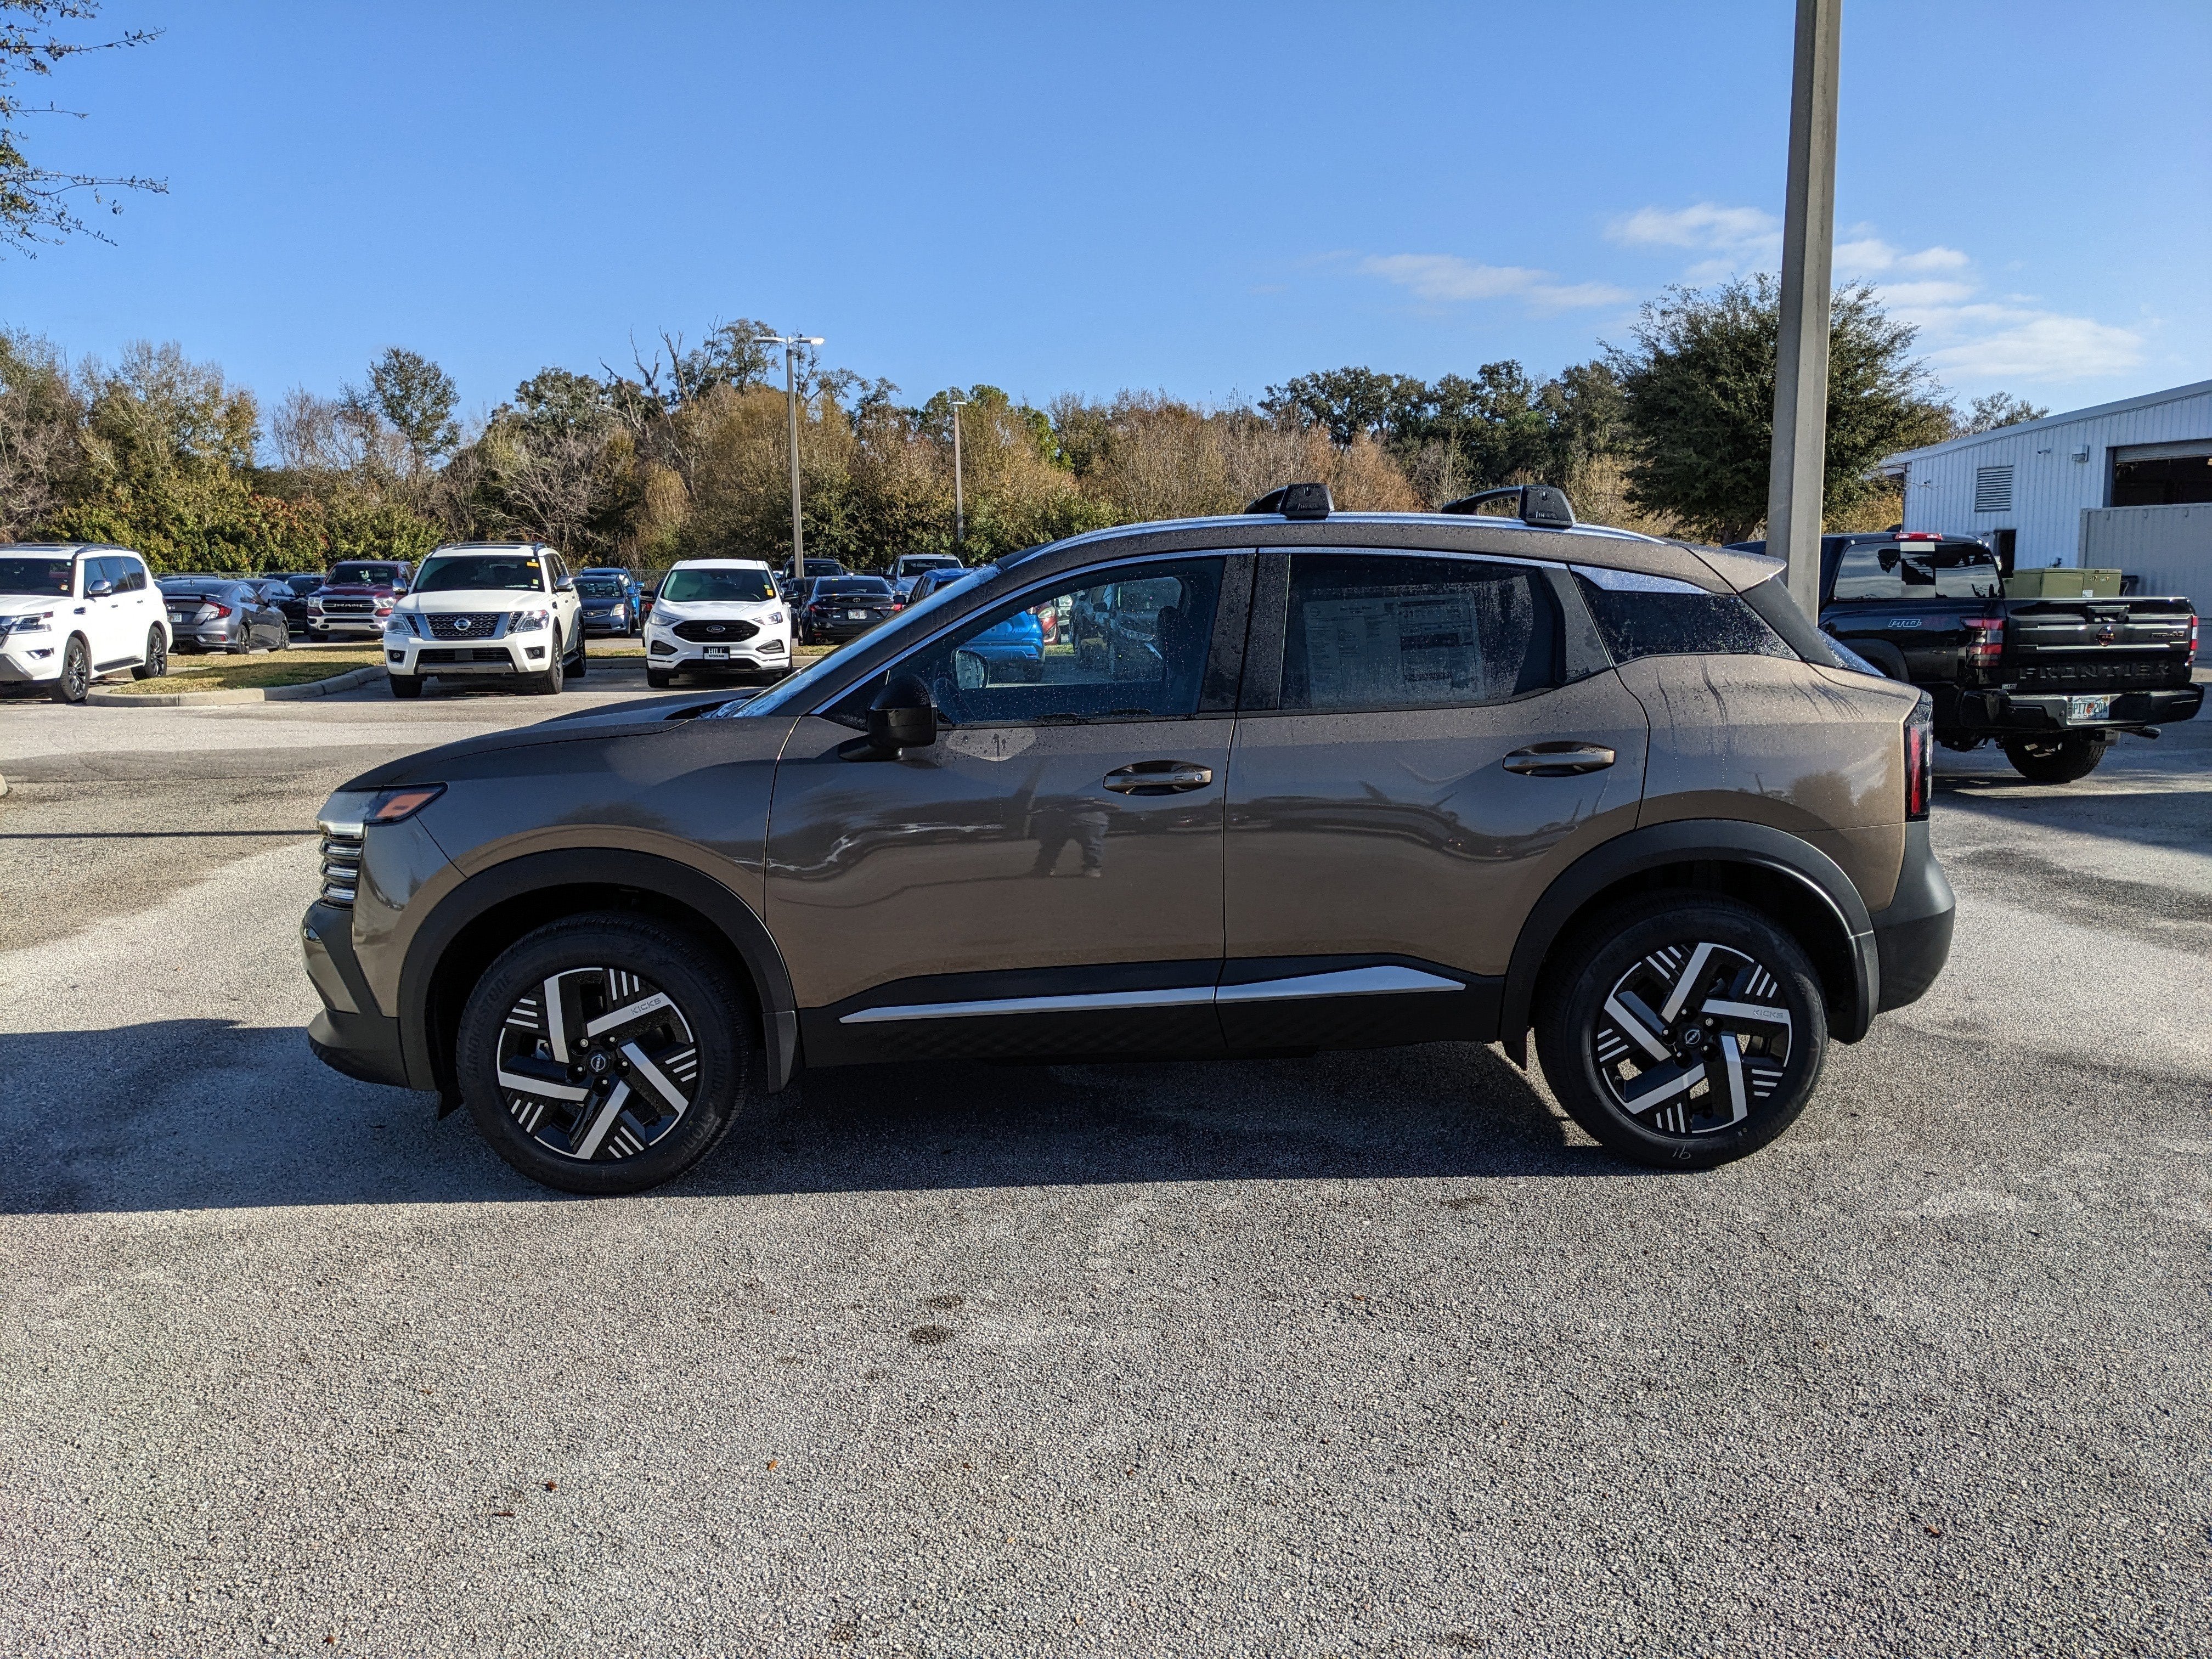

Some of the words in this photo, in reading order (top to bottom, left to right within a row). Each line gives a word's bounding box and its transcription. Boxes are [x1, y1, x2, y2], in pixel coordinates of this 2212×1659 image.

[2019, 664, 2169, 679] FRONTIER
[630, 997, 662, 1015] KICKS
[1753, 1009, 1784, 1018] KICKS
